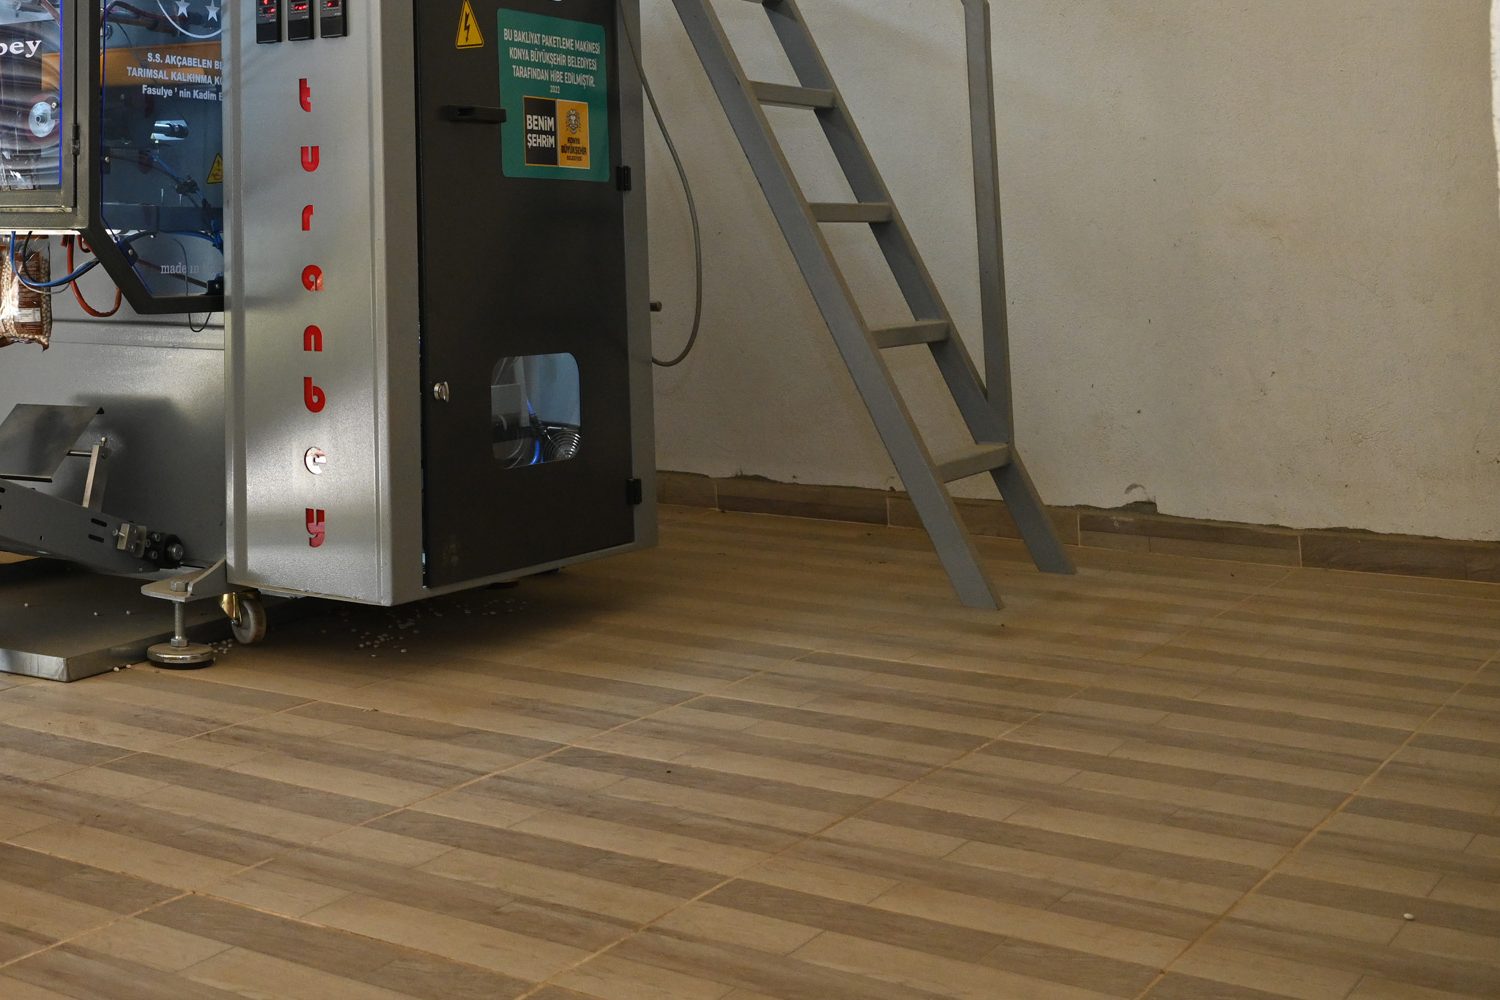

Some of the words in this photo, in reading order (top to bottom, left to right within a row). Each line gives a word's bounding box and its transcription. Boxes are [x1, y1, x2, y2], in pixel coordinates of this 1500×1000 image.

[504, 28, 513, 40] BU
[514, 30, 541, 45] BAKLİYAT
[541, 34, 574, 51] PAKETLEME
[574, 39, 600, 54] MAKİNESİ
[165, 54, 212, 70] AKÇABELEN
[509, 47, 529, 61] KONYA
[531, 48, 566, 68] BÜYÜKŞEHİR
[567, 55, 597, 71] BELEDİYESİ
[126, 66, 169, 80] TARIMSAL
[171, 72, 212, 85] KALKINMA
[512, 65, 549, 81] TARAFINDAN
[550, 70, 563, 83] HİBE
[142, 84, 173, 98] Fasulye
[179, 88, 191, 98] nin
[193, 90, 217, 100] Kadim
[550, 85, 560, 94] 2022
[526, 114, 555, 132] BENİM
[527, 134, 555, 149] ŞEHRİM
[160, 262, 187, 274] made
[298, 78, 326, 548] turanbey
